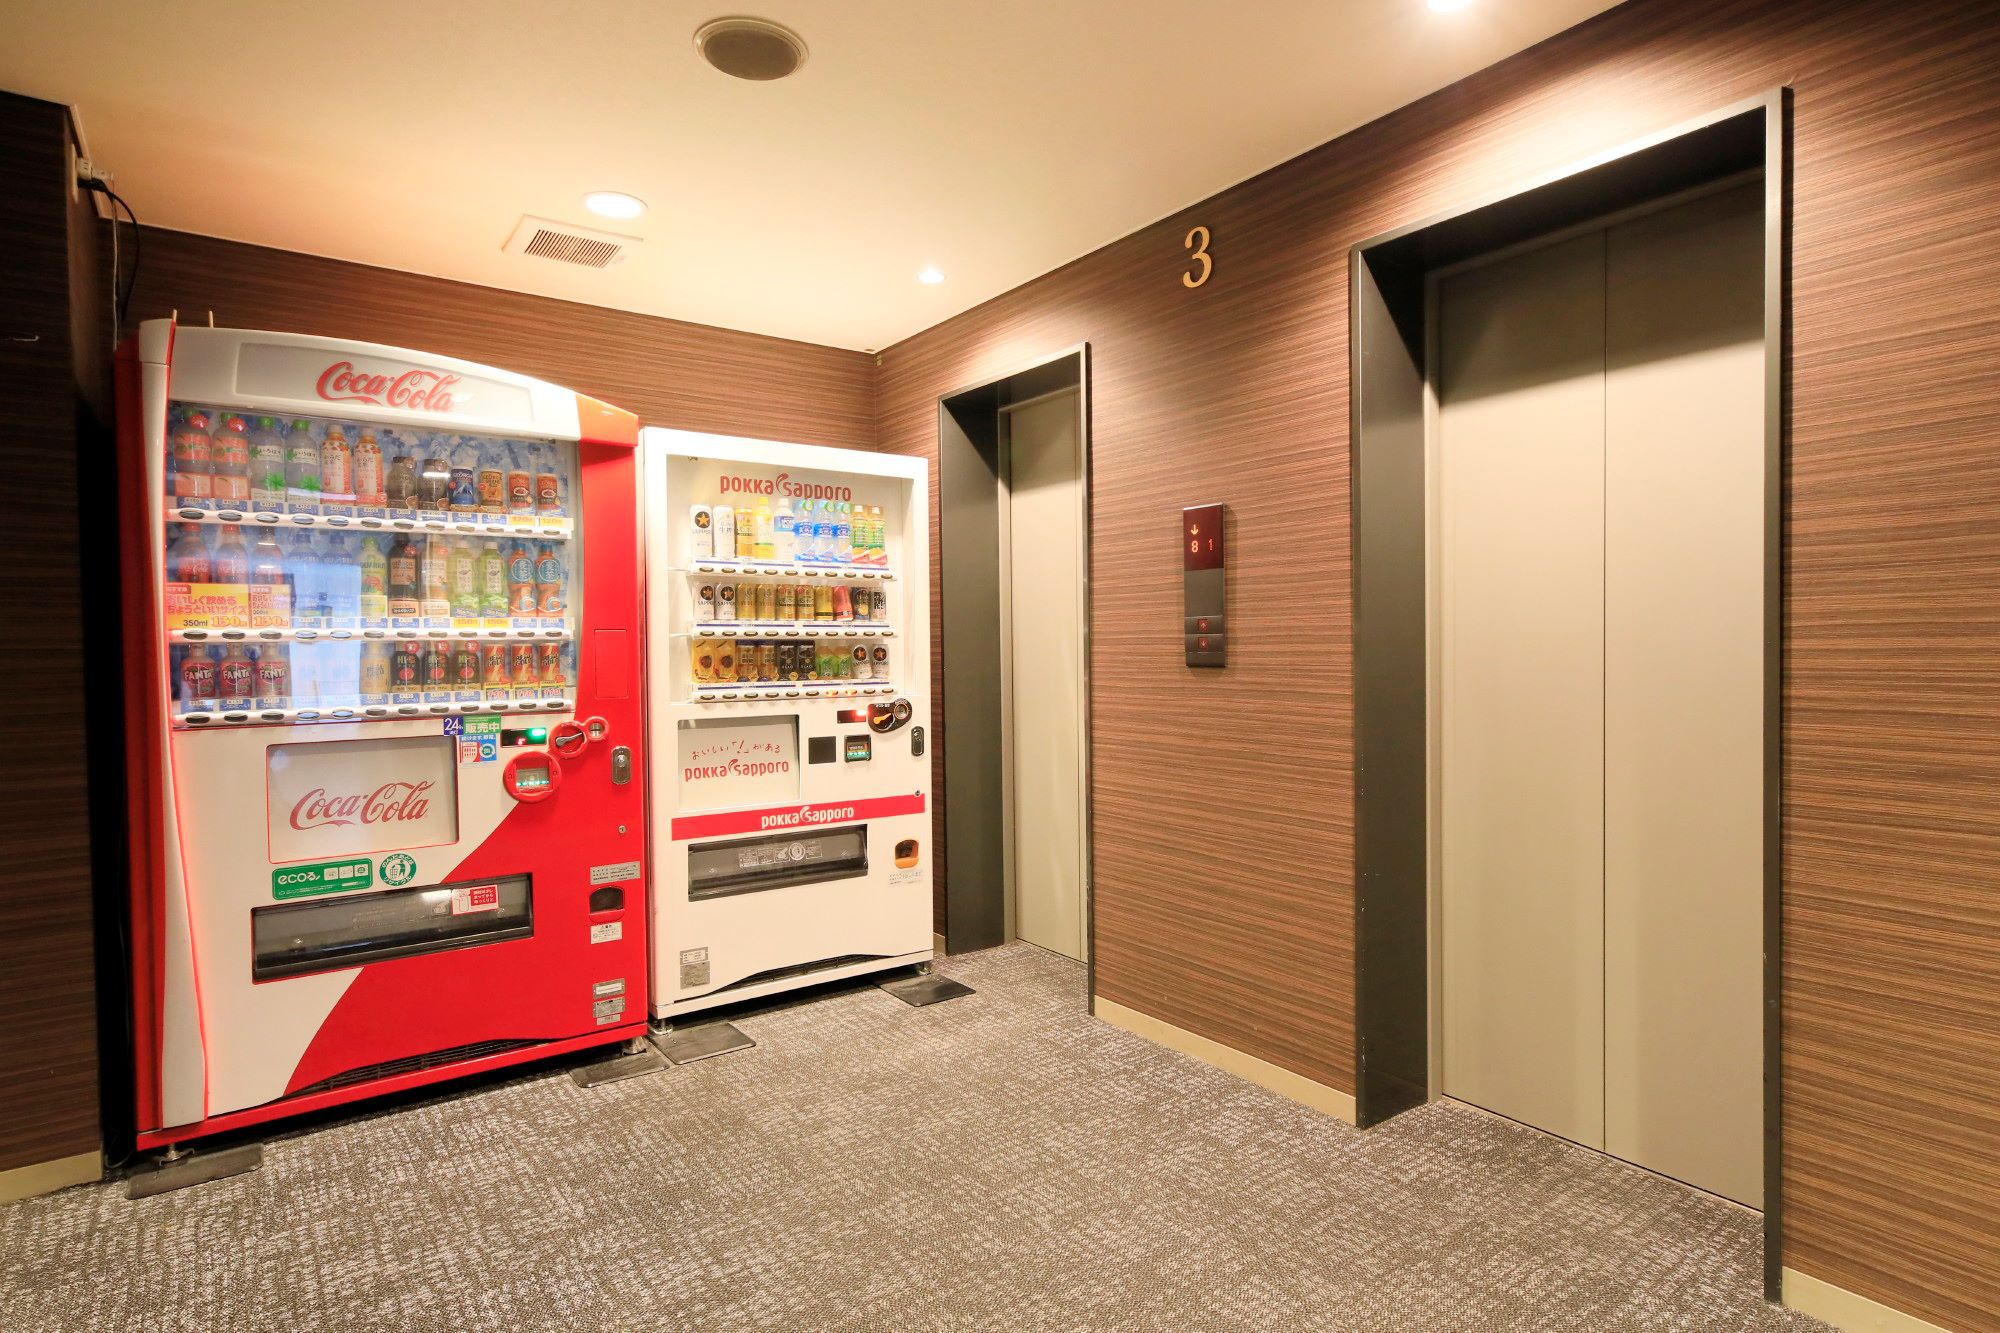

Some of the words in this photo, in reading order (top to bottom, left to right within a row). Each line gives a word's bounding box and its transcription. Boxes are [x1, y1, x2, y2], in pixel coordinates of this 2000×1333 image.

[1182, 226, 1212, 288] 3
[316, 360, 463, 413] Coca-Cola
[1191, 540, 1199, 553] 8
[1208, 538, 1213, 551] 1
[183, 619, 208, 627] 350ml
[184, 668, 213, 681] FANTA
[222, 668, 250, 680] FANTA
[259, 668, 287, 680] FANTA
[465, 722, 500, 734] 販売中
[289, 780, 437, 831] Coca-Cola
